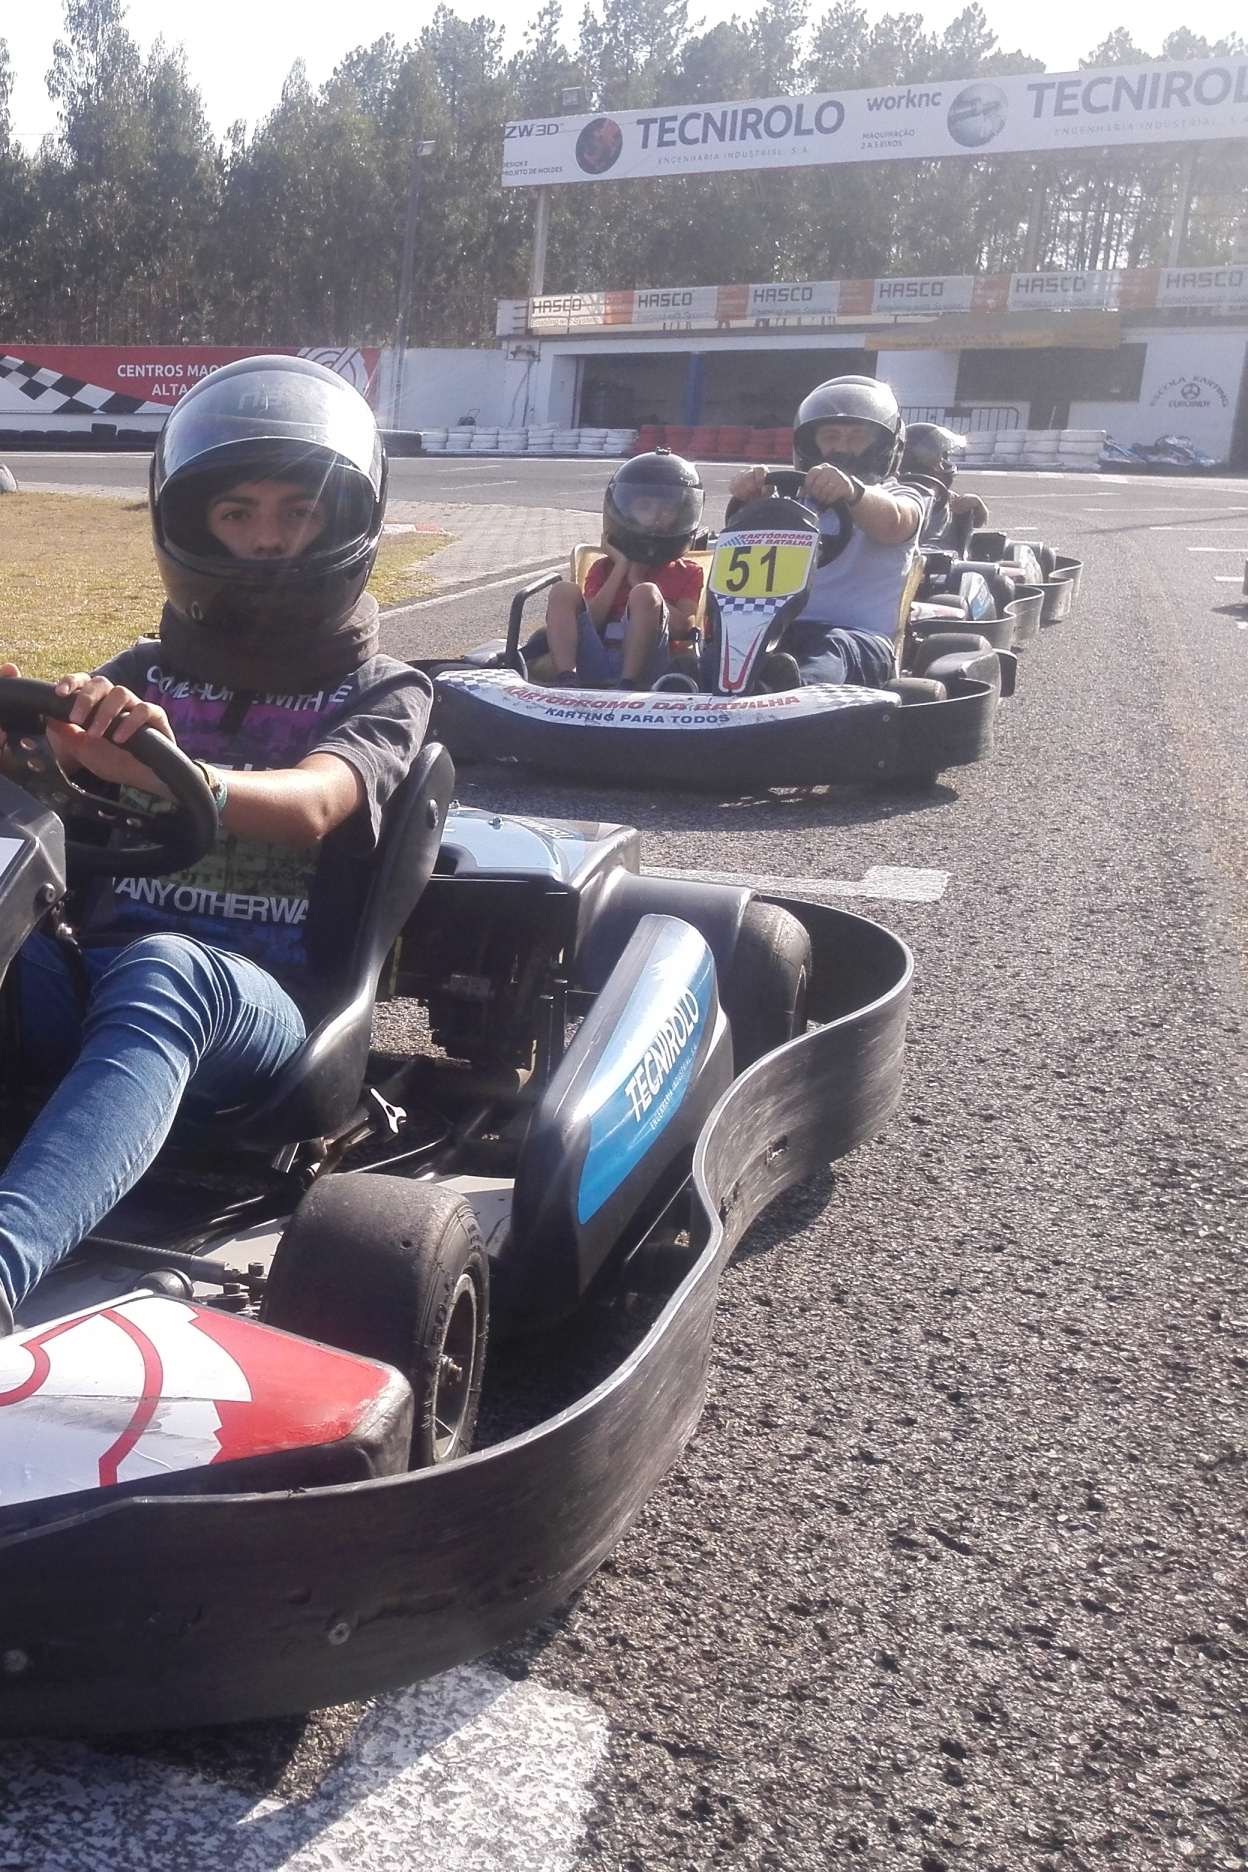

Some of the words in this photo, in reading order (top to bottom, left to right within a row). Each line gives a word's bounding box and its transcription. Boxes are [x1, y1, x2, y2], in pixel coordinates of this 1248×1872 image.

[866, 89, 942, 111] worknc
[636, 100, 845, 149] TECNIROLO
[1016, 276, 1087, 293] HASCO
[1166, 271, 1244, 289] HASCO
[753, 286, 813, 303] HASCO
[879, 281, 944, 298] HASCO
[532, 298, 582, 314] HASCO
[638, 292, 693, 309] HASCO
[116, 364, 183, 378] CENTROS
[726, 546, 778, 592] 51
[653, 700, 687, 711] DA
[545, 707, 615, 722] KARTING
[620, 713, 665, 724] PARA
[672, 713, 730, 724] TODOS
[624, 988, 700, 1122] TECNIROLO
